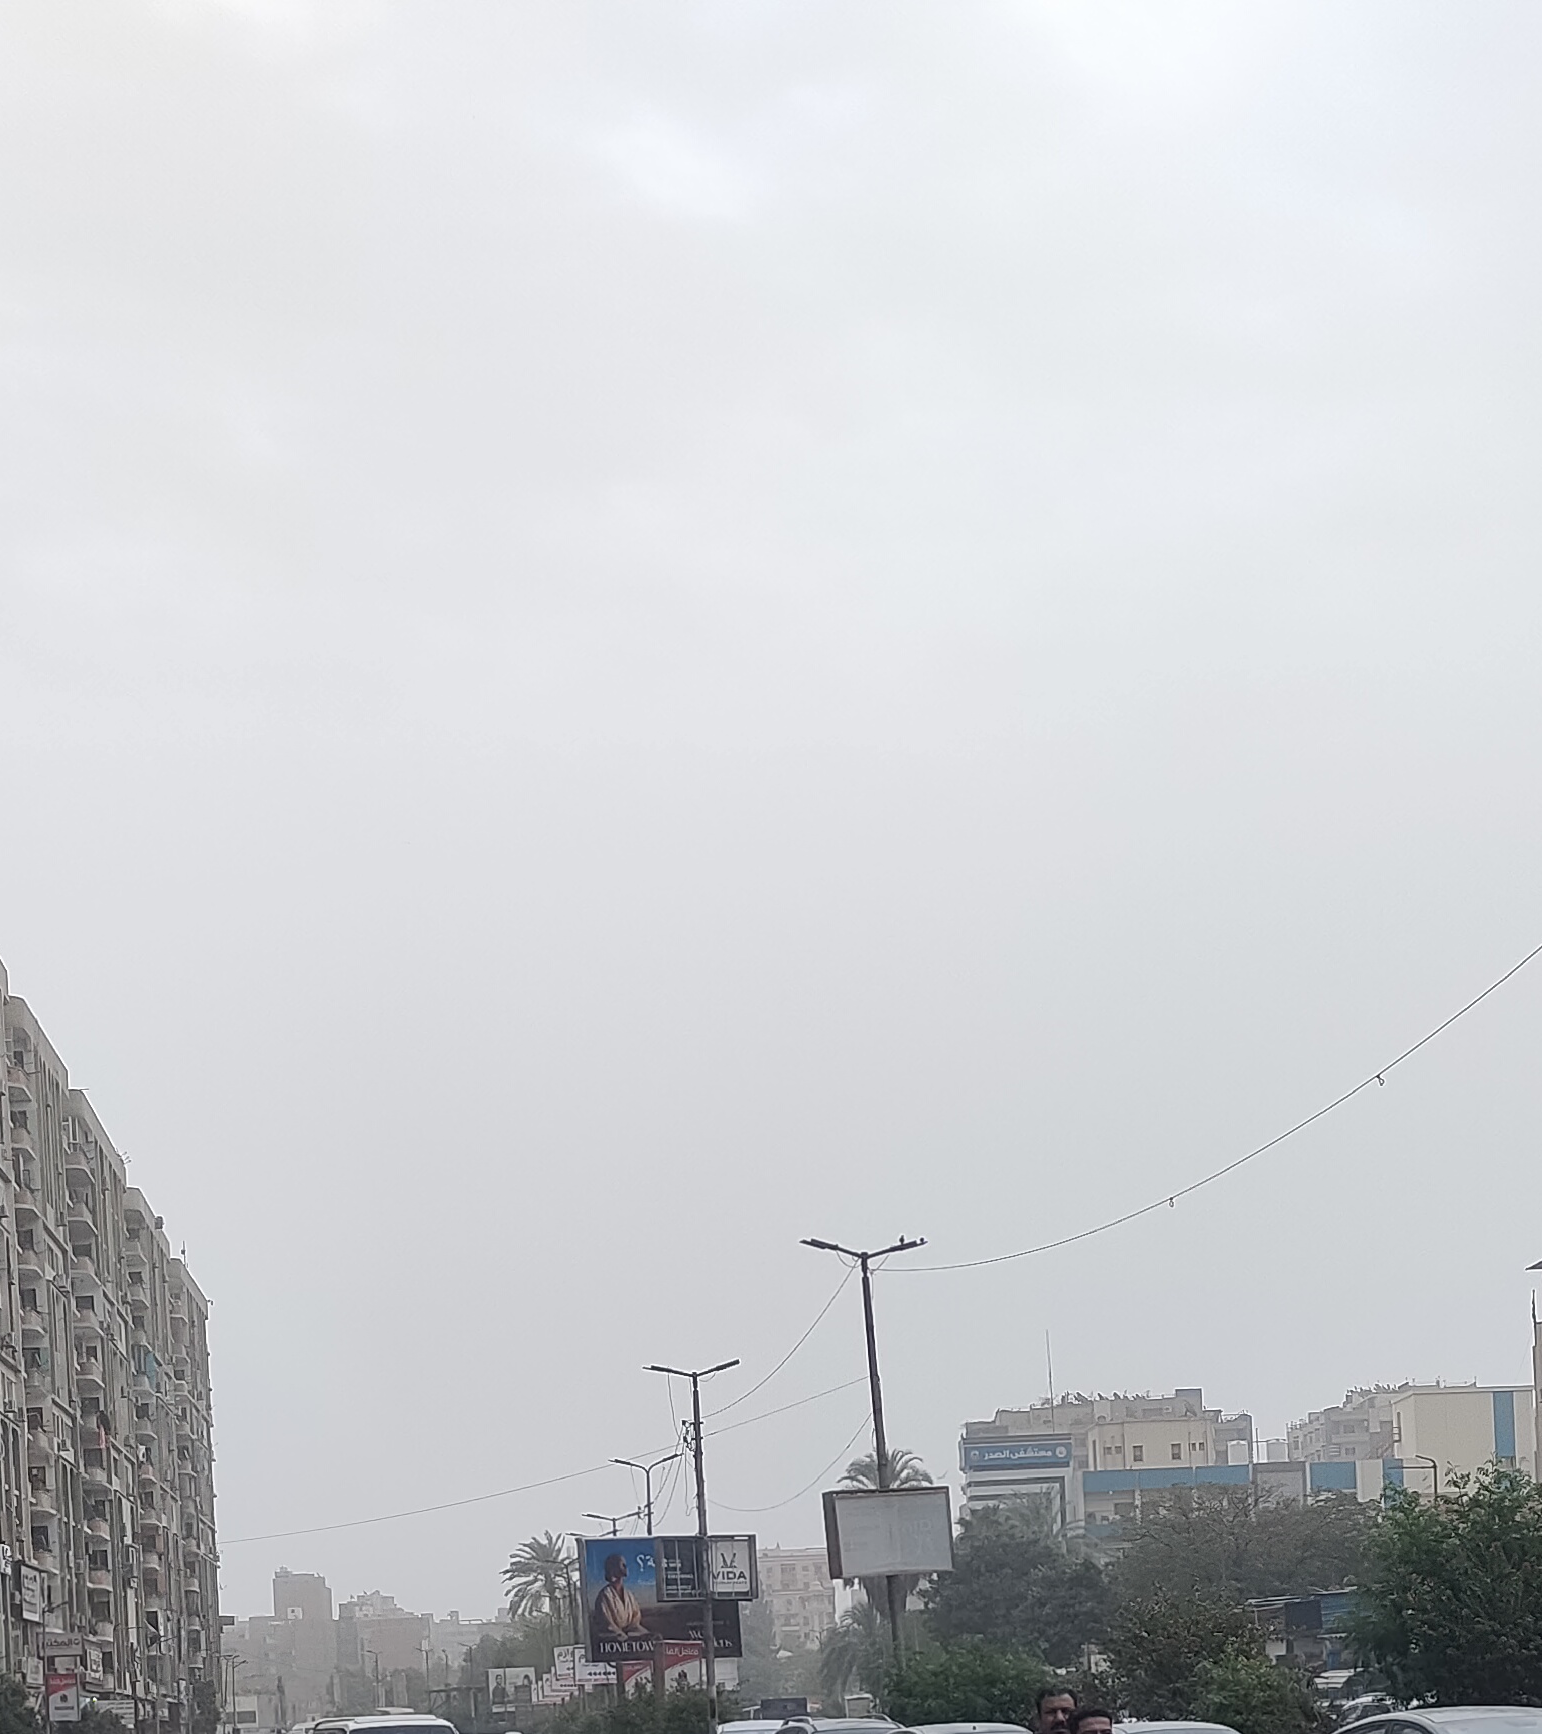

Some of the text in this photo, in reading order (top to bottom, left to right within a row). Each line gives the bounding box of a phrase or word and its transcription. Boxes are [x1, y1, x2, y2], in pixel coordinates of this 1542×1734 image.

[983, 1447, 1053, 1460] مستشفى الصدر
[599, 1641, 656, 1654] HOMETOW
